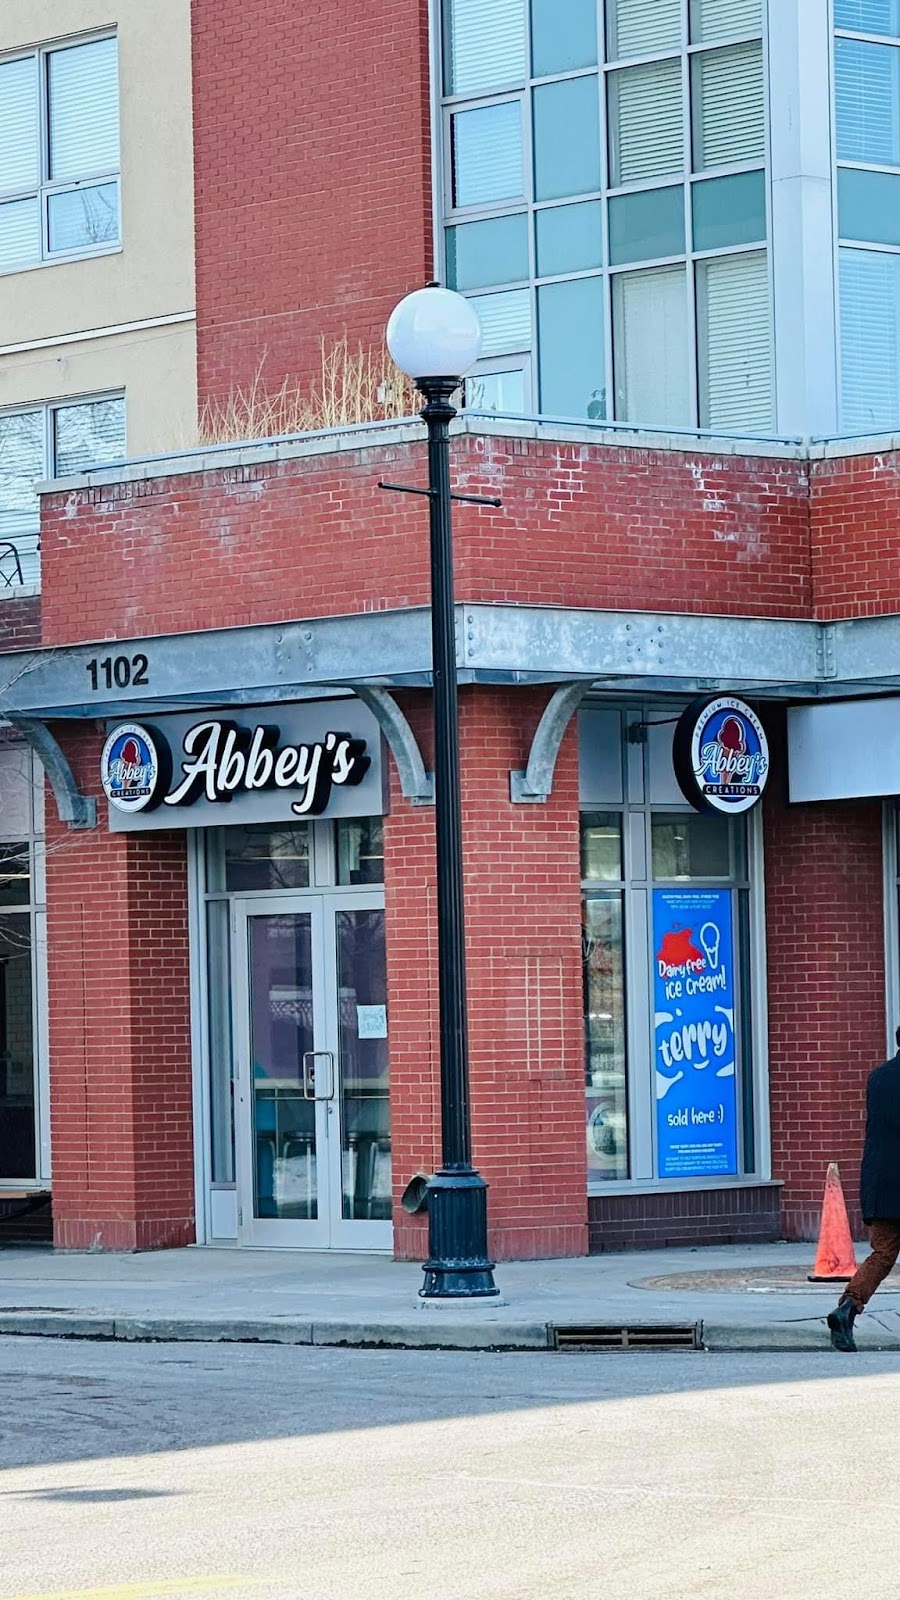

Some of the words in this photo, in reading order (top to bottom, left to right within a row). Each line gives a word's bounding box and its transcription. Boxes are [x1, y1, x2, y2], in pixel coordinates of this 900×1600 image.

[86, 654, 149, 690] 1102
[695, 702, 722, 738] PREMIUM
[726, 699, 740, 709] ICE
[744, 708, 764, 740] CREAM
[104, 757, 156, 787] Abbey's
[164, 721, 355, 814] Abbey's
[693, 741, 768, 784] Abbey's
[705, 785, 758, 795] CREATIONS
[658, 960, 686, 978] Dairy
[686, 958, 707, 975] free
[658, 1020, 728, 1068] terry
[667, 1108, 688, 1126] sold
[691, 1106, 715, 1125] here
